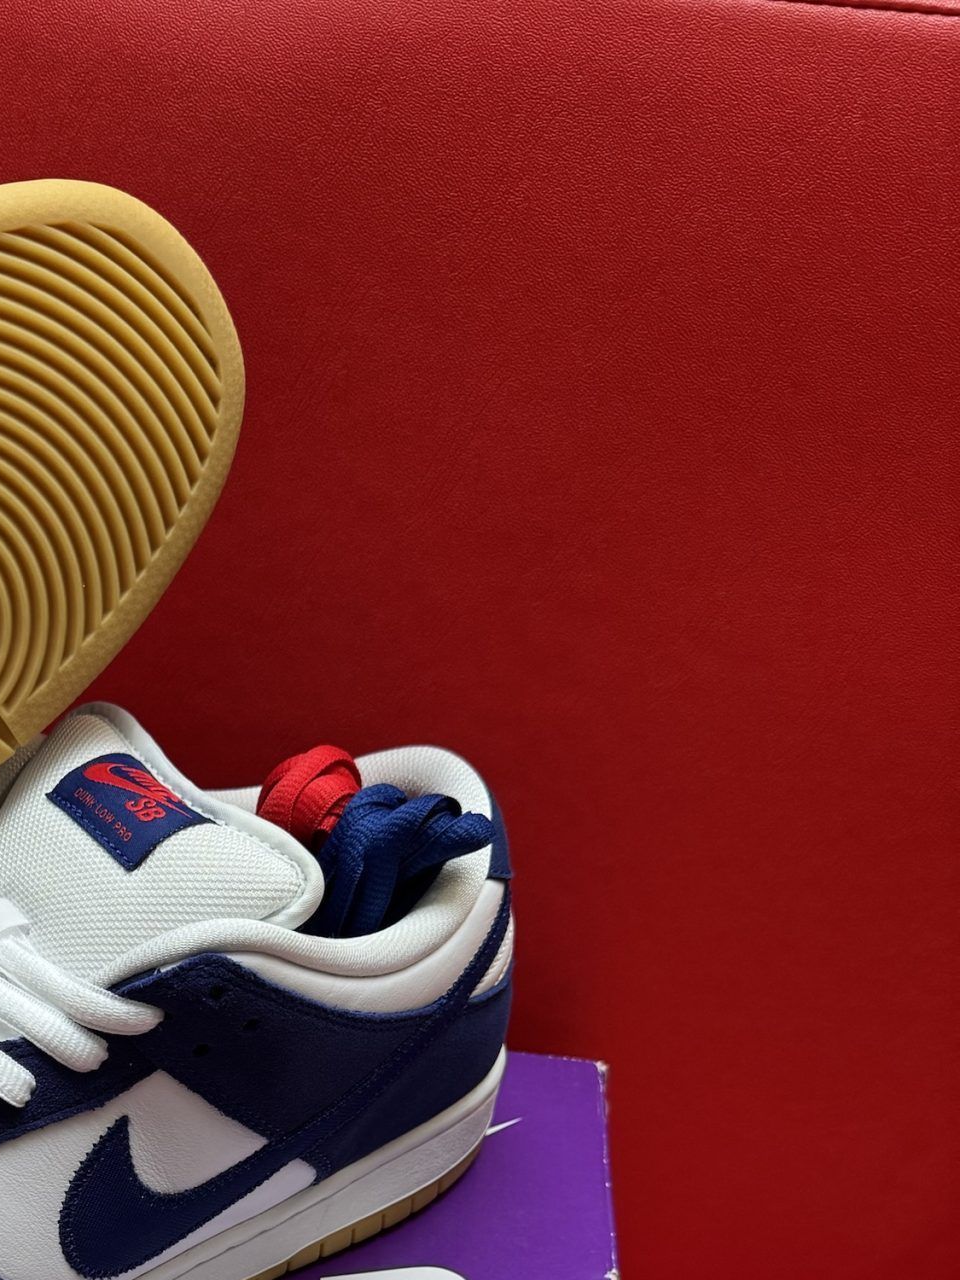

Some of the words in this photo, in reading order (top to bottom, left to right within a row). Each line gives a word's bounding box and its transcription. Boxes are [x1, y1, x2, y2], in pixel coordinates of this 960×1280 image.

[74, 787, 95, 808] DUNK
[95, 805, 115, 824] LOW
[114, 822, 133, 842] PRO
[125, 797, 166, 822] SB
